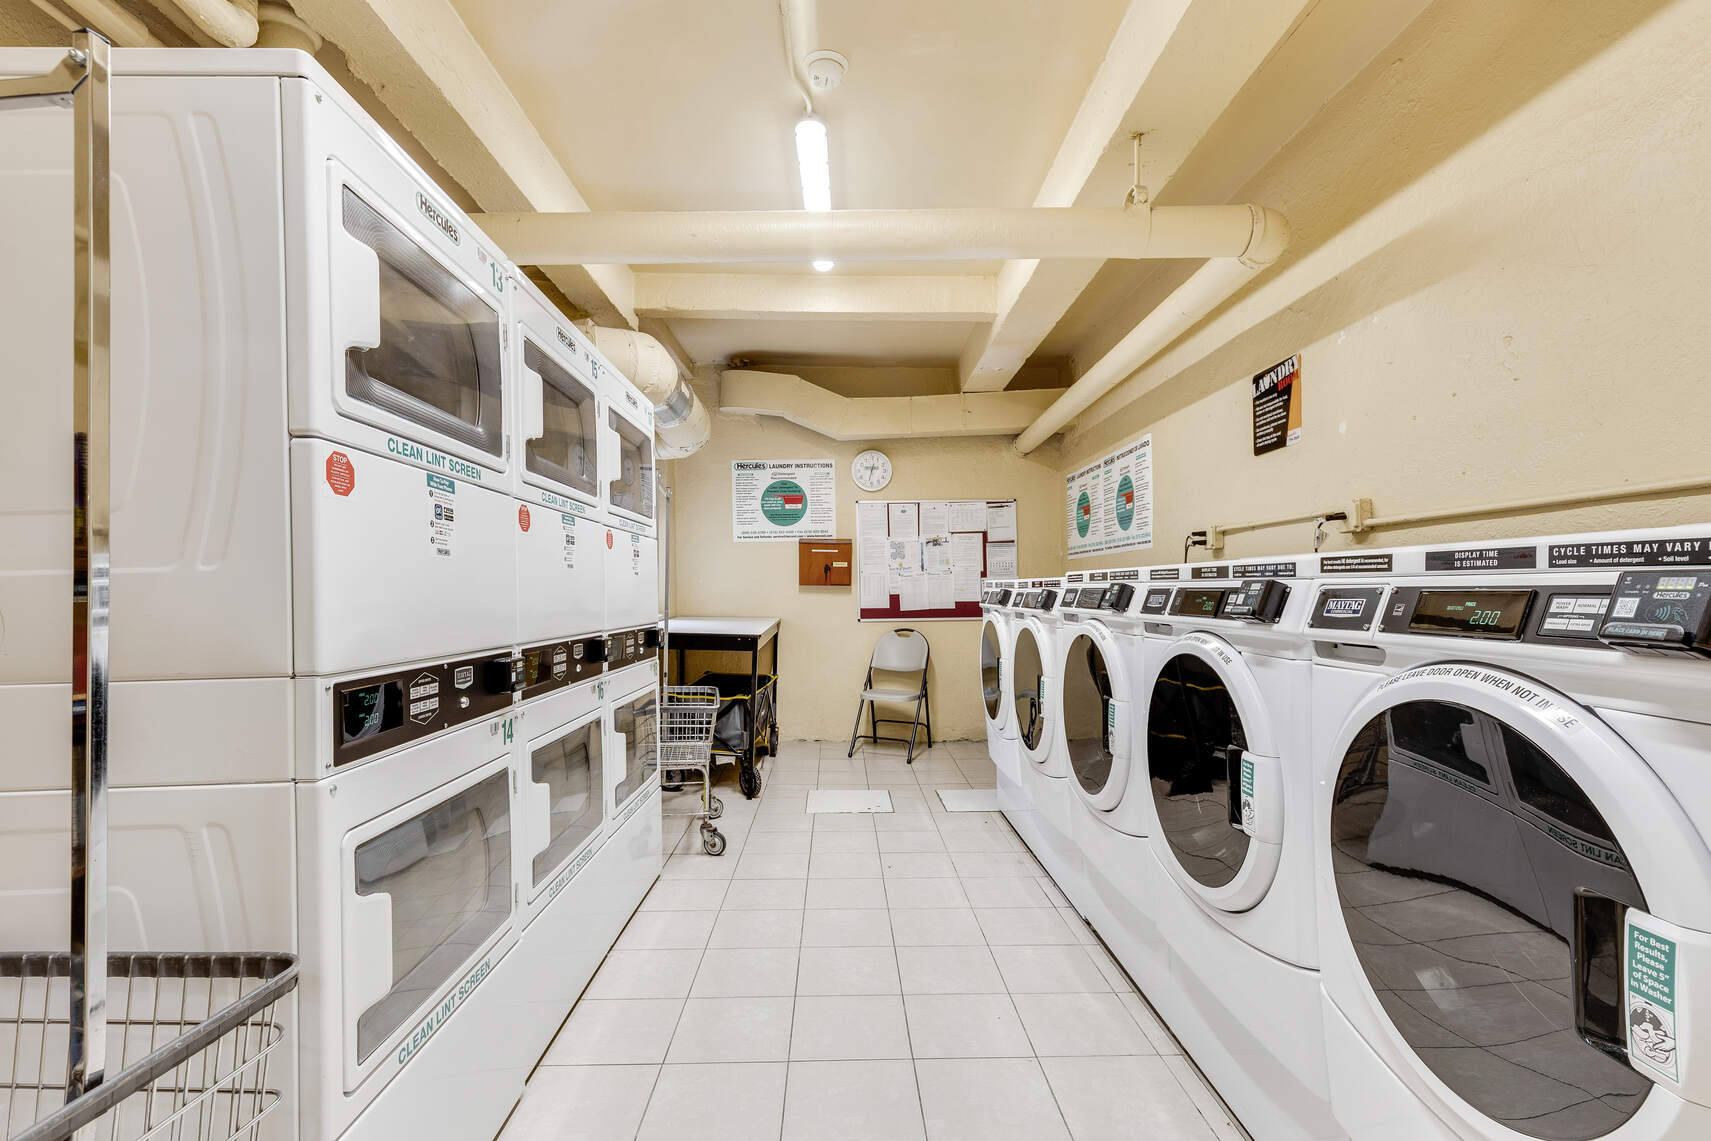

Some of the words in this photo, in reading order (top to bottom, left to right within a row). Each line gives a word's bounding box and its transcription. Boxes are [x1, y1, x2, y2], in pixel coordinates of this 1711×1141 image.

[420, 191, 458, 242] Hercules
[490, 261, 504, 293] 13
[332, 454, 348, 464] STOP
[387, 437, 423, 462] CLEAN
[426, 450, 447, 469] LINT
[448, 458, 481, 481] SCREEN
[736, 462, 766, 470] Hercules
[541, 491, 558, 506] CLEAN
[1454, 551, 1480, 559] DISPLAY
[1482, 550, 1499, 558] TIME
[1553, 546, 1586, 556] CYCLE
[1591, 545, 1627, 555] TIMES
[1633, 543, 1659, 553] MAY
[1666, 541, 1701, 552] VARY
[1663, 554, 1675, 562] Soil
[1675, 554, 1689, 562] level
[1454, 560, 1461, 568] IS
[1462, 559, 1498, 567] ESTIMATED
[1619, 556, 1645, 564] detergent
[1656, 591, 1688, 599] Hercules
[1327, 600, 1362, 610] MAYTAG
[1469, 610, 1501, 626] 2.00
[1401, 668, 1428, 681] LEAVE
[1426, 667, 1454, 676] DOOR
[1453, 668, 1481, 681] OPEN
[1480, 673, 1515, 691] WHEN
[1511, 684, 1540, 702] NOT
[1535, 698, 1555, 711] IN
[501, 718, 514, 746] 14
[547, 875, 566, 898] CLEAN
[565, 863, 576, 881] LINT
[575, 847, 593, 870] SCREEN
[1633, 930, 1649, 943] For
[1649, 937, 1671, 953] Best
[1634, 940, 1669, 964] Results,
[1636, 951, 1665, 971] Please
[1632, 960, 1658, 978] Leave
[1632, 971, 1643, 980] of
[1643, 974, 1670, 994] Space
[1639, 982, 1673, 1005] Washer
[398, 1017, 434, 1065] CLEAN
[436, 993, 457, 1025] LINT
[458, 958, 491, 1001] SCREEN
